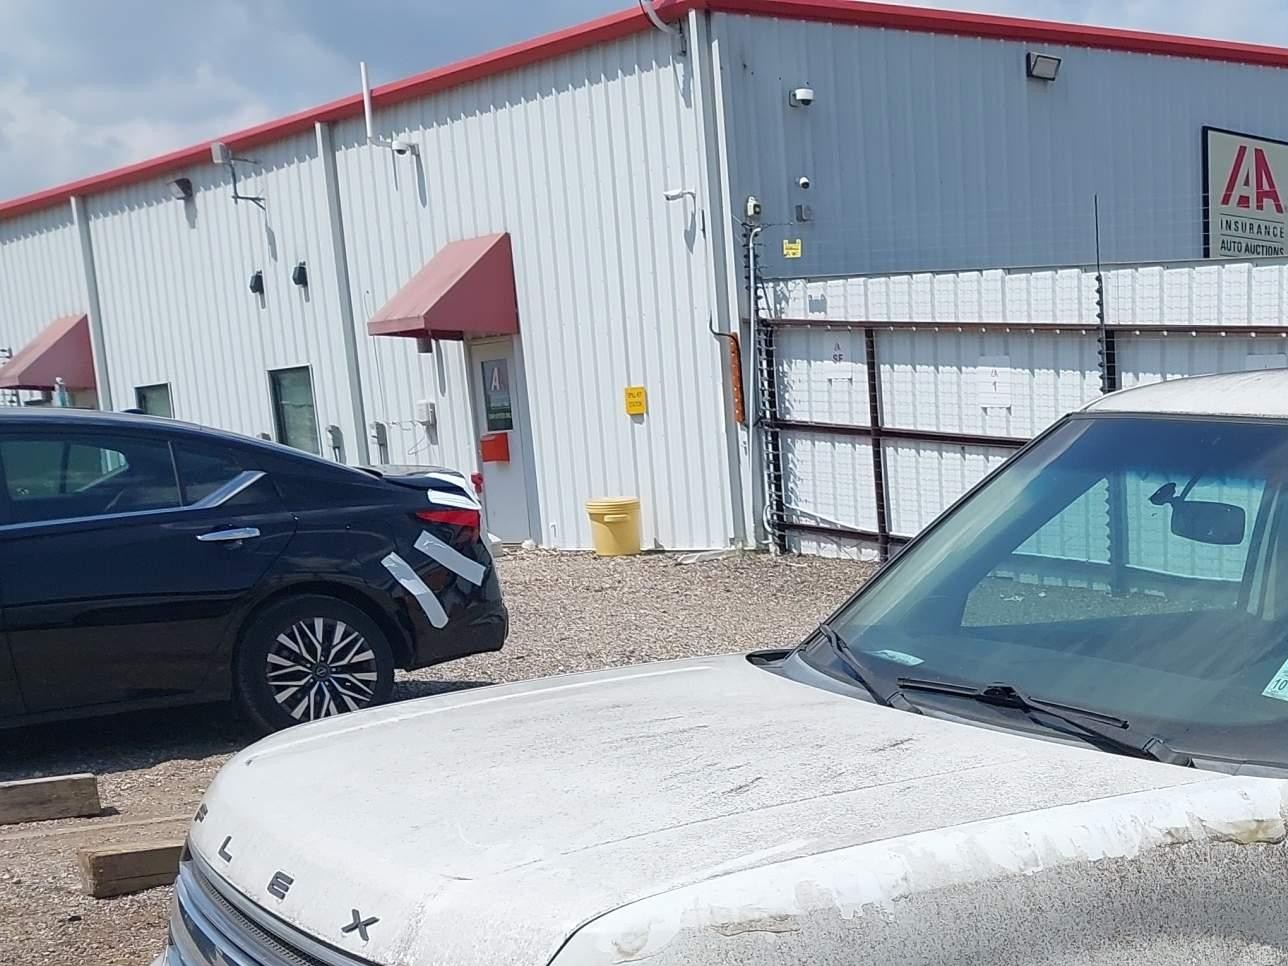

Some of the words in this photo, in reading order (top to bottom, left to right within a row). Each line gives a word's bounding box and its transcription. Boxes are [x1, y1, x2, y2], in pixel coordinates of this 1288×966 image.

[1220, 218, 1285, 239] INSURANCE
[1220, 239, 1243, 253] AUTO
[1244, 243, 1285, 257] AUCTIONS
[1272, 679, 1288, 691] 10
